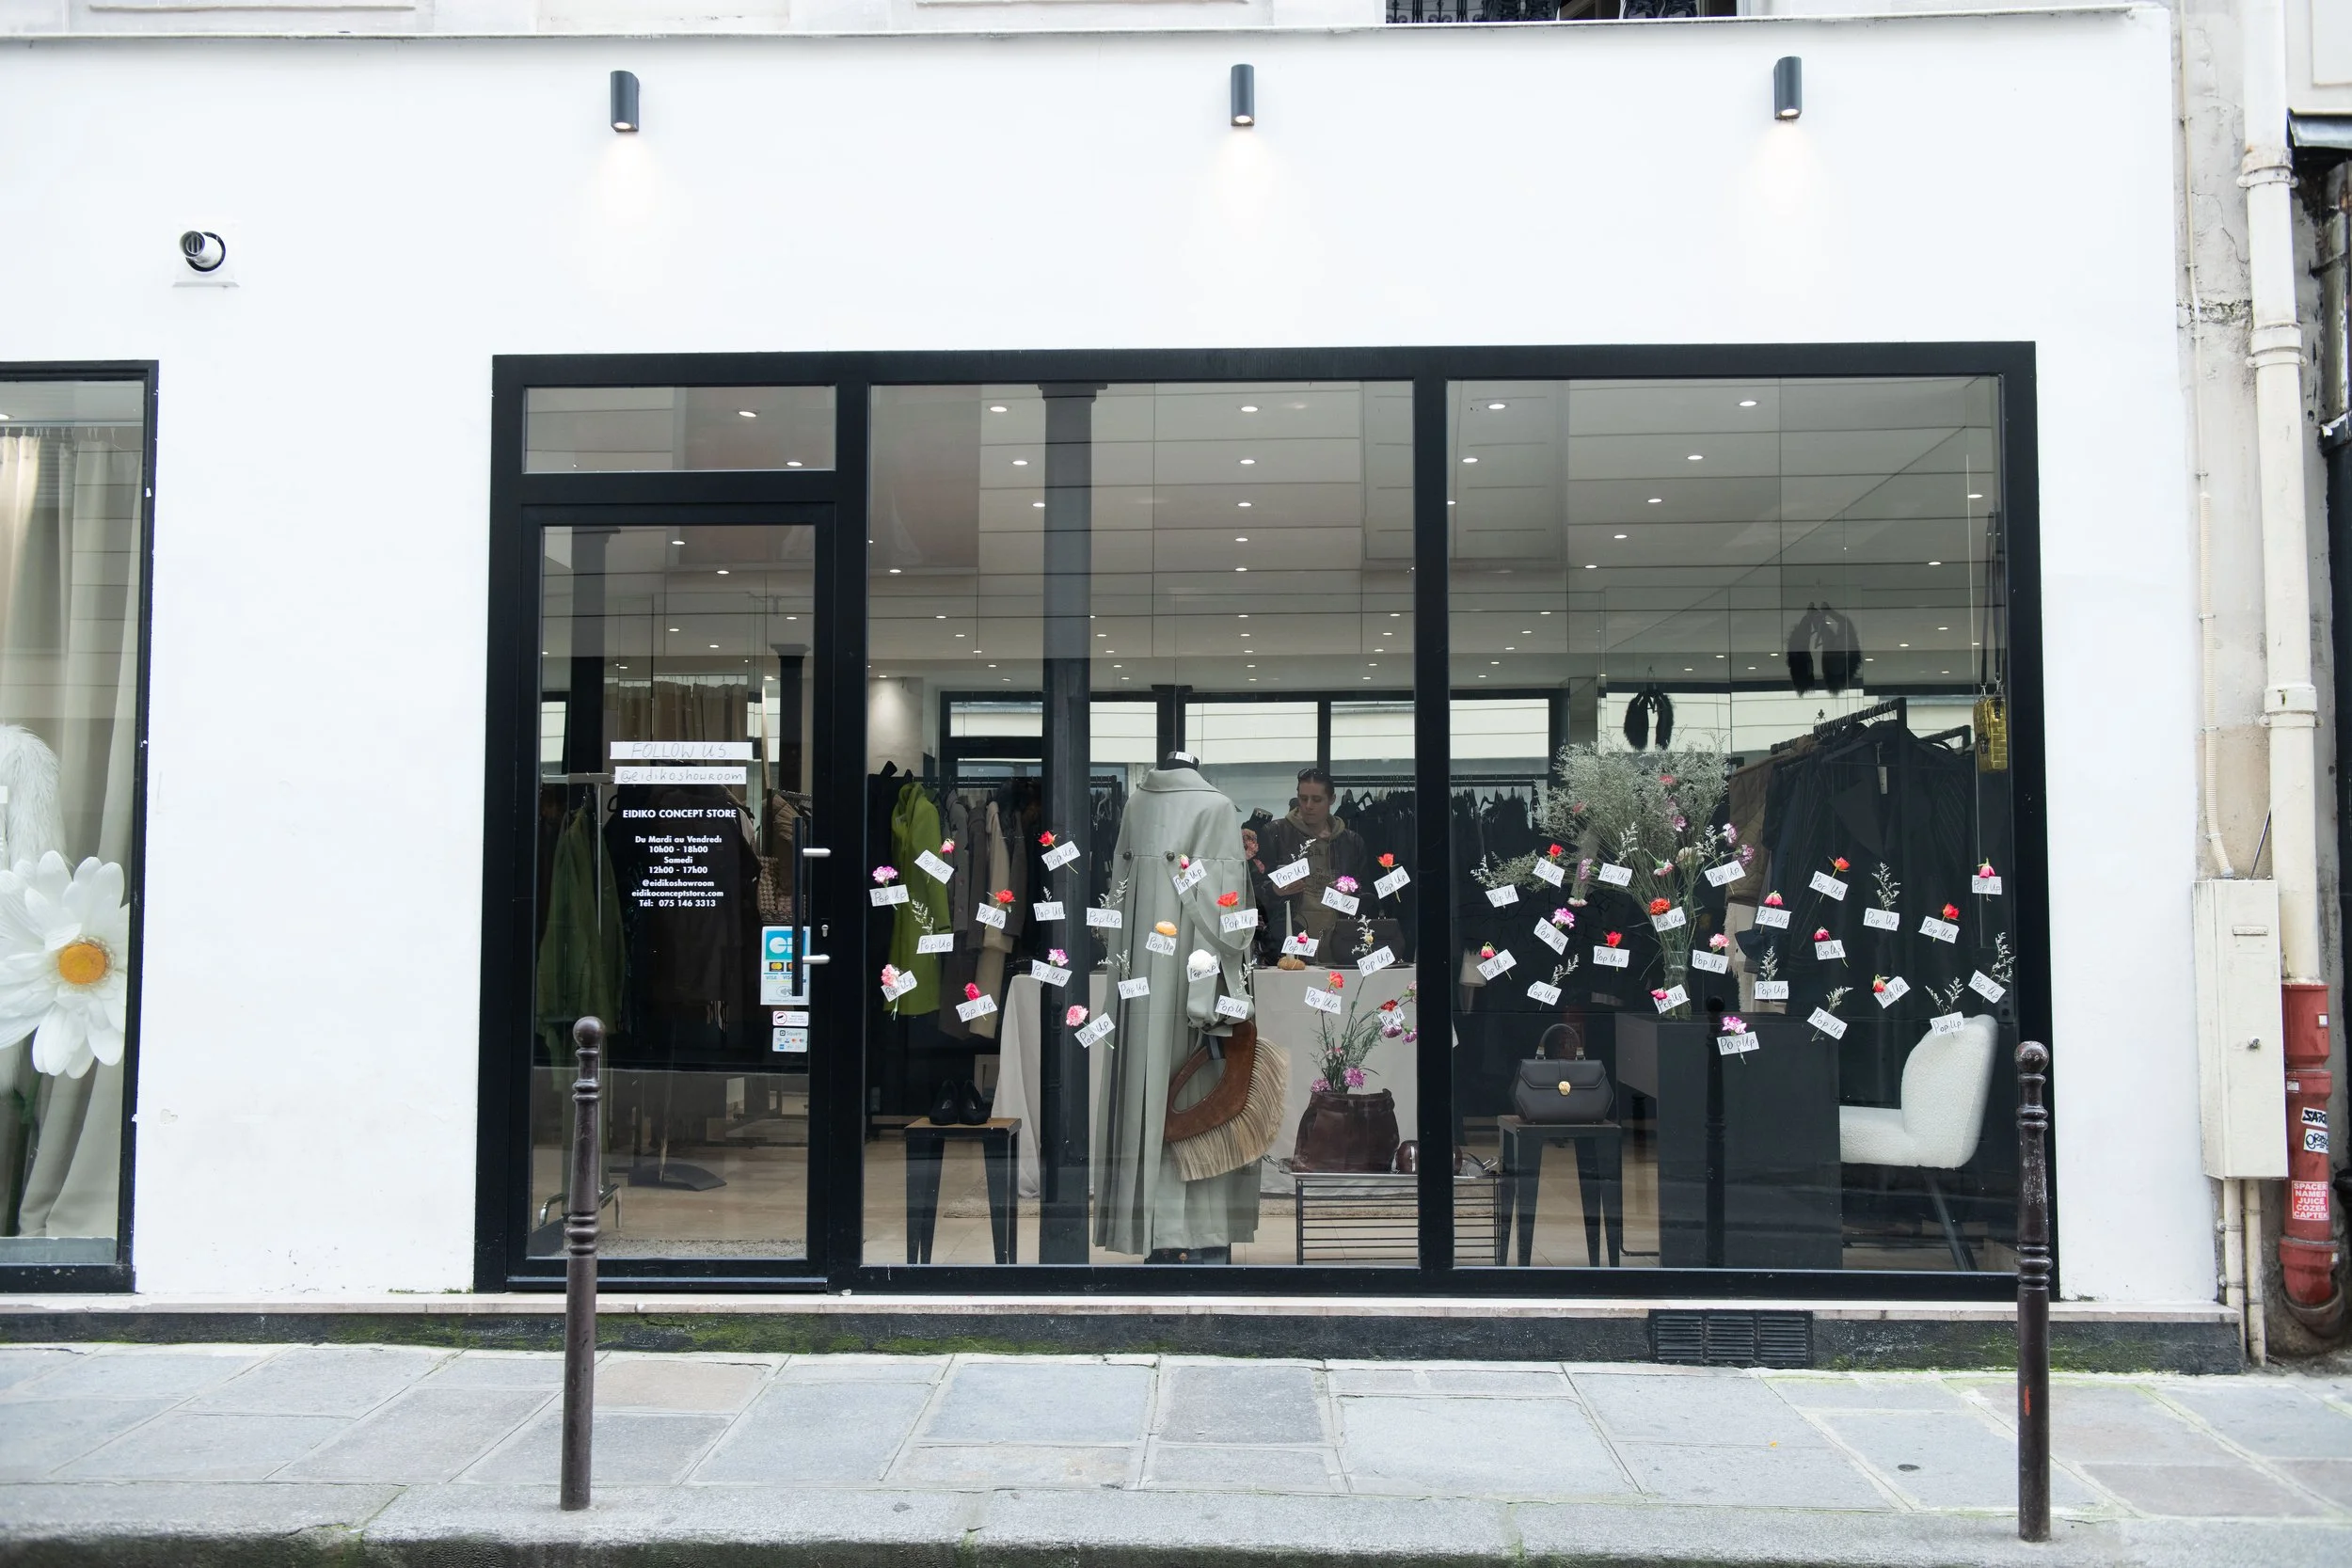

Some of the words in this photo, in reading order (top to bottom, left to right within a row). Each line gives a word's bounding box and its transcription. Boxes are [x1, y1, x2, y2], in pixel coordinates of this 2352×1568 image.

[631, 742, 695, 758] FOLLOW
[623, 810, 657, 818] EIDIKO
[659, 810, 704, 818] CONCEPT
[707, 809, 737, 818] STORE
[1046, 854, 1062, 865] Pop
[1062, 847, 1074, 857] Up
[922, 854, 934, 868] Pop
[935, 864, 948, 876] Up
[1535, 863, 1547, 876] Pop
[1549, 868, 1560, 881] Up
[1176, 878, 1190, 891] Pop
[1190, 868, 1202, 879] Up
[1276, 871, 1293, 884] Pop
[1295, 864, 1307, 875] Up
[1601, 866, 1615, 880] Pop
[1617, 871, 1629, 883] Up
[1710, 871, 1724, 883] Pop
[1726, 866, 1739, 878] Up
[1378, 881, 1393, 892] Pop
[1394, 873, 1406, 884] Up
[1812, 875, 1826, 890] Pop
[1832, 883, 1844, 895] Up
[1974, 879, 1987, 893] Pop
[1990, 880, 2001, 893] Up
[631, 889, 724, 898] eidikoconceptstore.com
[874, 892, 889, 903] Pop
[1490, 894, 1504, 905] Pop
[1504, 891, 1516, 900] Up
[1326, 893, 1339, 905] Pop
[1343, 898, 1355, 911] Up
[978, 908, 991, 922] Pop
[993, 915, 1004, 926] Up
[1036, 906, 1050, 918] Pop
[1052, 906, 1063, 918] Up
[1089, 911, 1104, 924] Pop
[1105, 914, 1120, 926] Up
[1758, 910, 1772, 924] Pop
[1775, 914, 1788, 926] Up
[1866, 911, 1880, 925] Pop
[1886, 914, 1896, 927] Up
[1224, 917, 1240, 929] Pop
[1241, 915, 1253, 926] Up
[1656, 918, 1668, 929] Pop
[1671, 914, 1683, 926] Up
[1923, 920, 1937, 935] Pop
[1940, 928, 1953, 939] Up
[921, 939, 936, 950] Pop
[939, 941, 951, 949] Up
[1536, 924, 1549, 940] Pop
[1553, 936, 1564, 949] Up
[1150, 937, 1163, 950] Pop
[1163, 941, 1174, 953] Up
[1284, 940, 1299, 953] Pop
[1302, 943, 1313, 955] Up
[1818, 944, 1829, 956] Pop
[1830, 944, 1842, 956] Up
[1359, 959, 1375, 972] Pop
[1377, 952, 1391, 962] Up
[1596, 949, 1609, 962] Pop
[1610, 953, 1623, 963] Up
[1694, 954, 1708, 968] Pop
[1710, 958, 1723, 970] Up
[1034, 964, 1049, 979] Pop
[1052, 971, 1065, 983] Up
[1482, 965, 1495, 977] Pop
[1494, 958, 1507, 970] Up
[885, 986, 898, 997] Pop
[899, 977, 914, 988] Up
[1120, 983, 1135, 994] Pop
[1136, 982, 1147, 991] Up
[1531, 985, 1542, 997] Pop
[1544, 990, 1556, 1001] Up
[1757, 984, 1772, 997] Pop
[1774, 984, 1787, 994] Up
[1881, 990, 1893, 1002] Pop
[1893, 984, 1904, 994] Up
[1972, 976, 1985, 990] Pop
[1988, 987, 1998, 1000] Up
[1218, 999, 1234, 1013] Pop
[1235, 1004, 1246, 1015] Up
[1308, 990, 1321, 1005] Pop
[1324, 998, 1338, 1009] Up
[1658, 998, 1673, 1009] Pop
[1672, 992, 1683, 1005] Up
[960, 1007, 976, 1018] Pop
[979, 1001, 993, 1011] Up
[1382, 1016, 1394, 1026] Pop
[1393, 1010, 1403, 1020] Up
[1812, 1011, 1828, 1027] Pop
[1830, 1022, 1842, 1035] Up
[1079, 1031, 1095, 1045] Pop
[1096, 1021, 1109, 1032] Up
[1932, 1021, 1948, 1033] Pop
[1950, 1020, 1962, 1029] Up
[1721, 1038, 1741, 1052] Pop
[1741, 1037, 1755, 1050] Up
